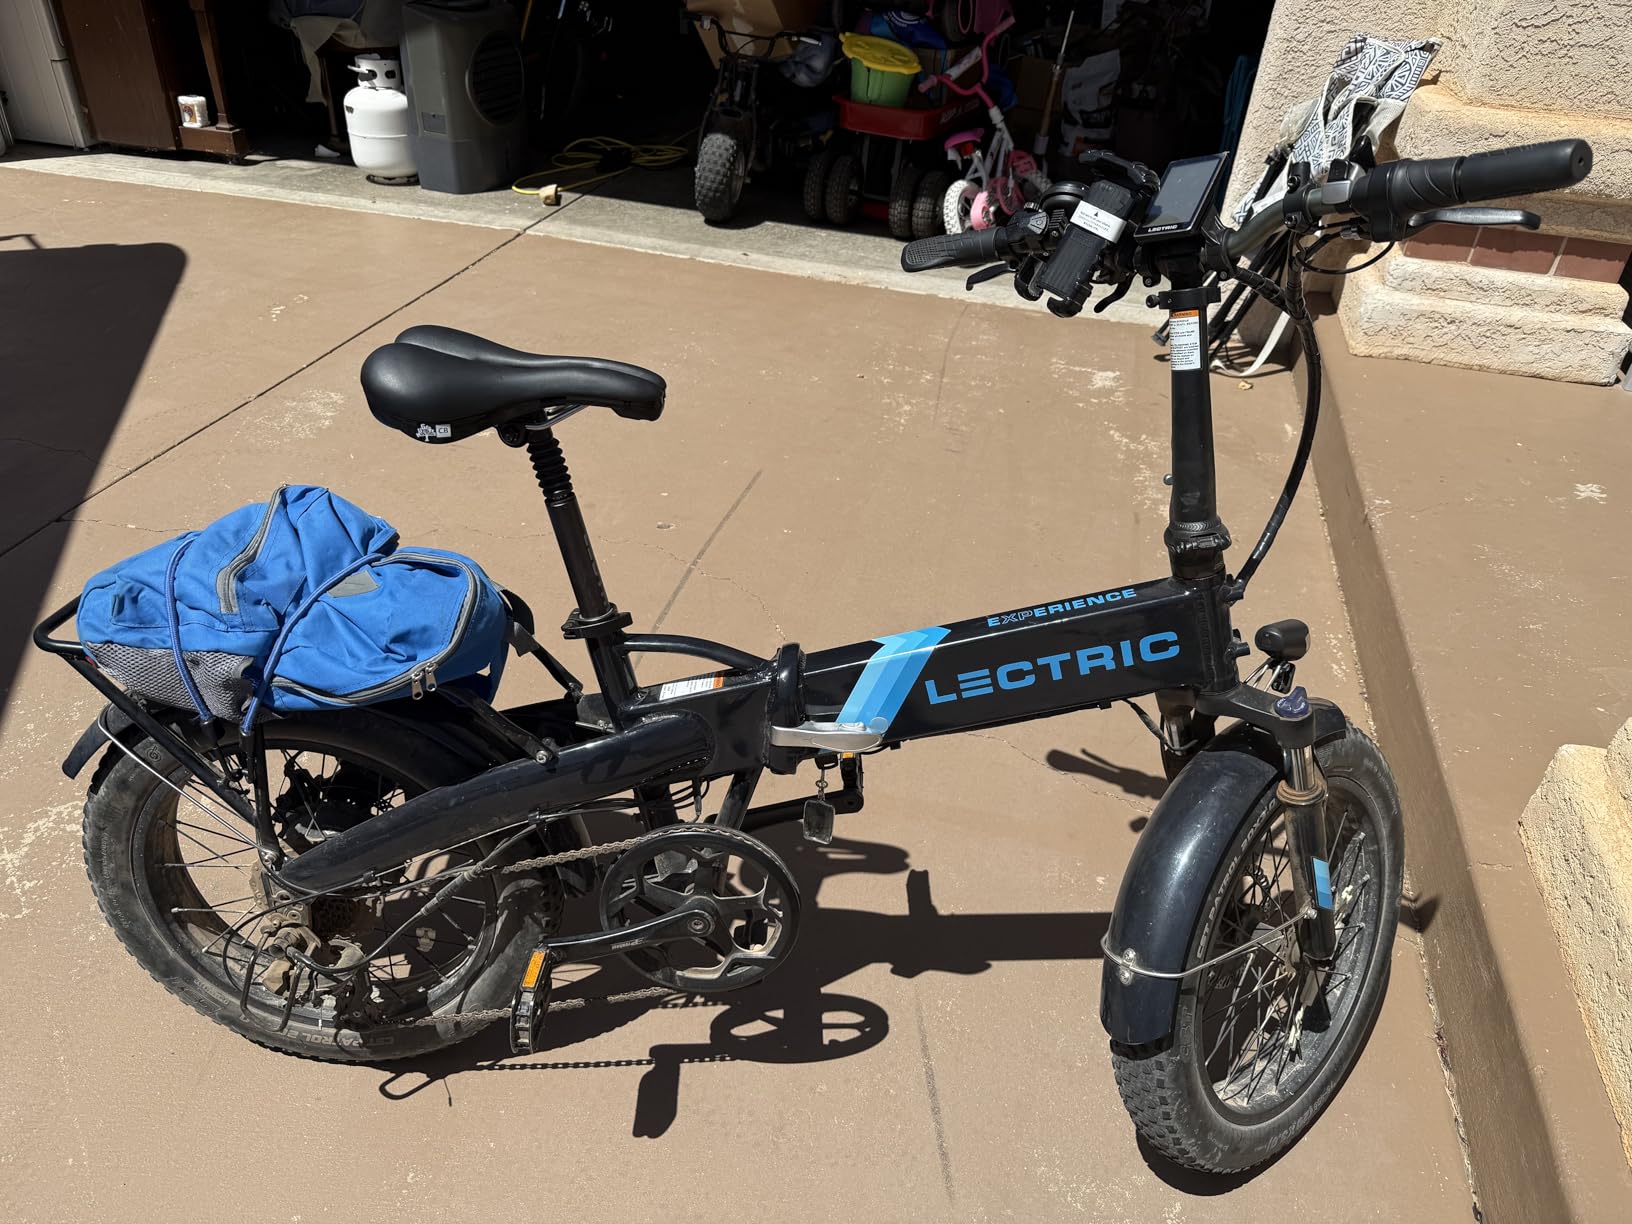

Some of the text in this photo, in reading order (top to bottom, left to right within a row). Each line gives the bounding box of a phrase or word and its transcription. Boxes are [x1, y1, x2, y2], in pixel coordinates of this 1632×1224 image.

[1147, 224, 1178, 233] LECTRIC
[987, 588, 1137, 627] EXPERIENCE
[925, 631, 1180, 705] LECTRIC
[1209, 856, 1241, 921] PATROL
